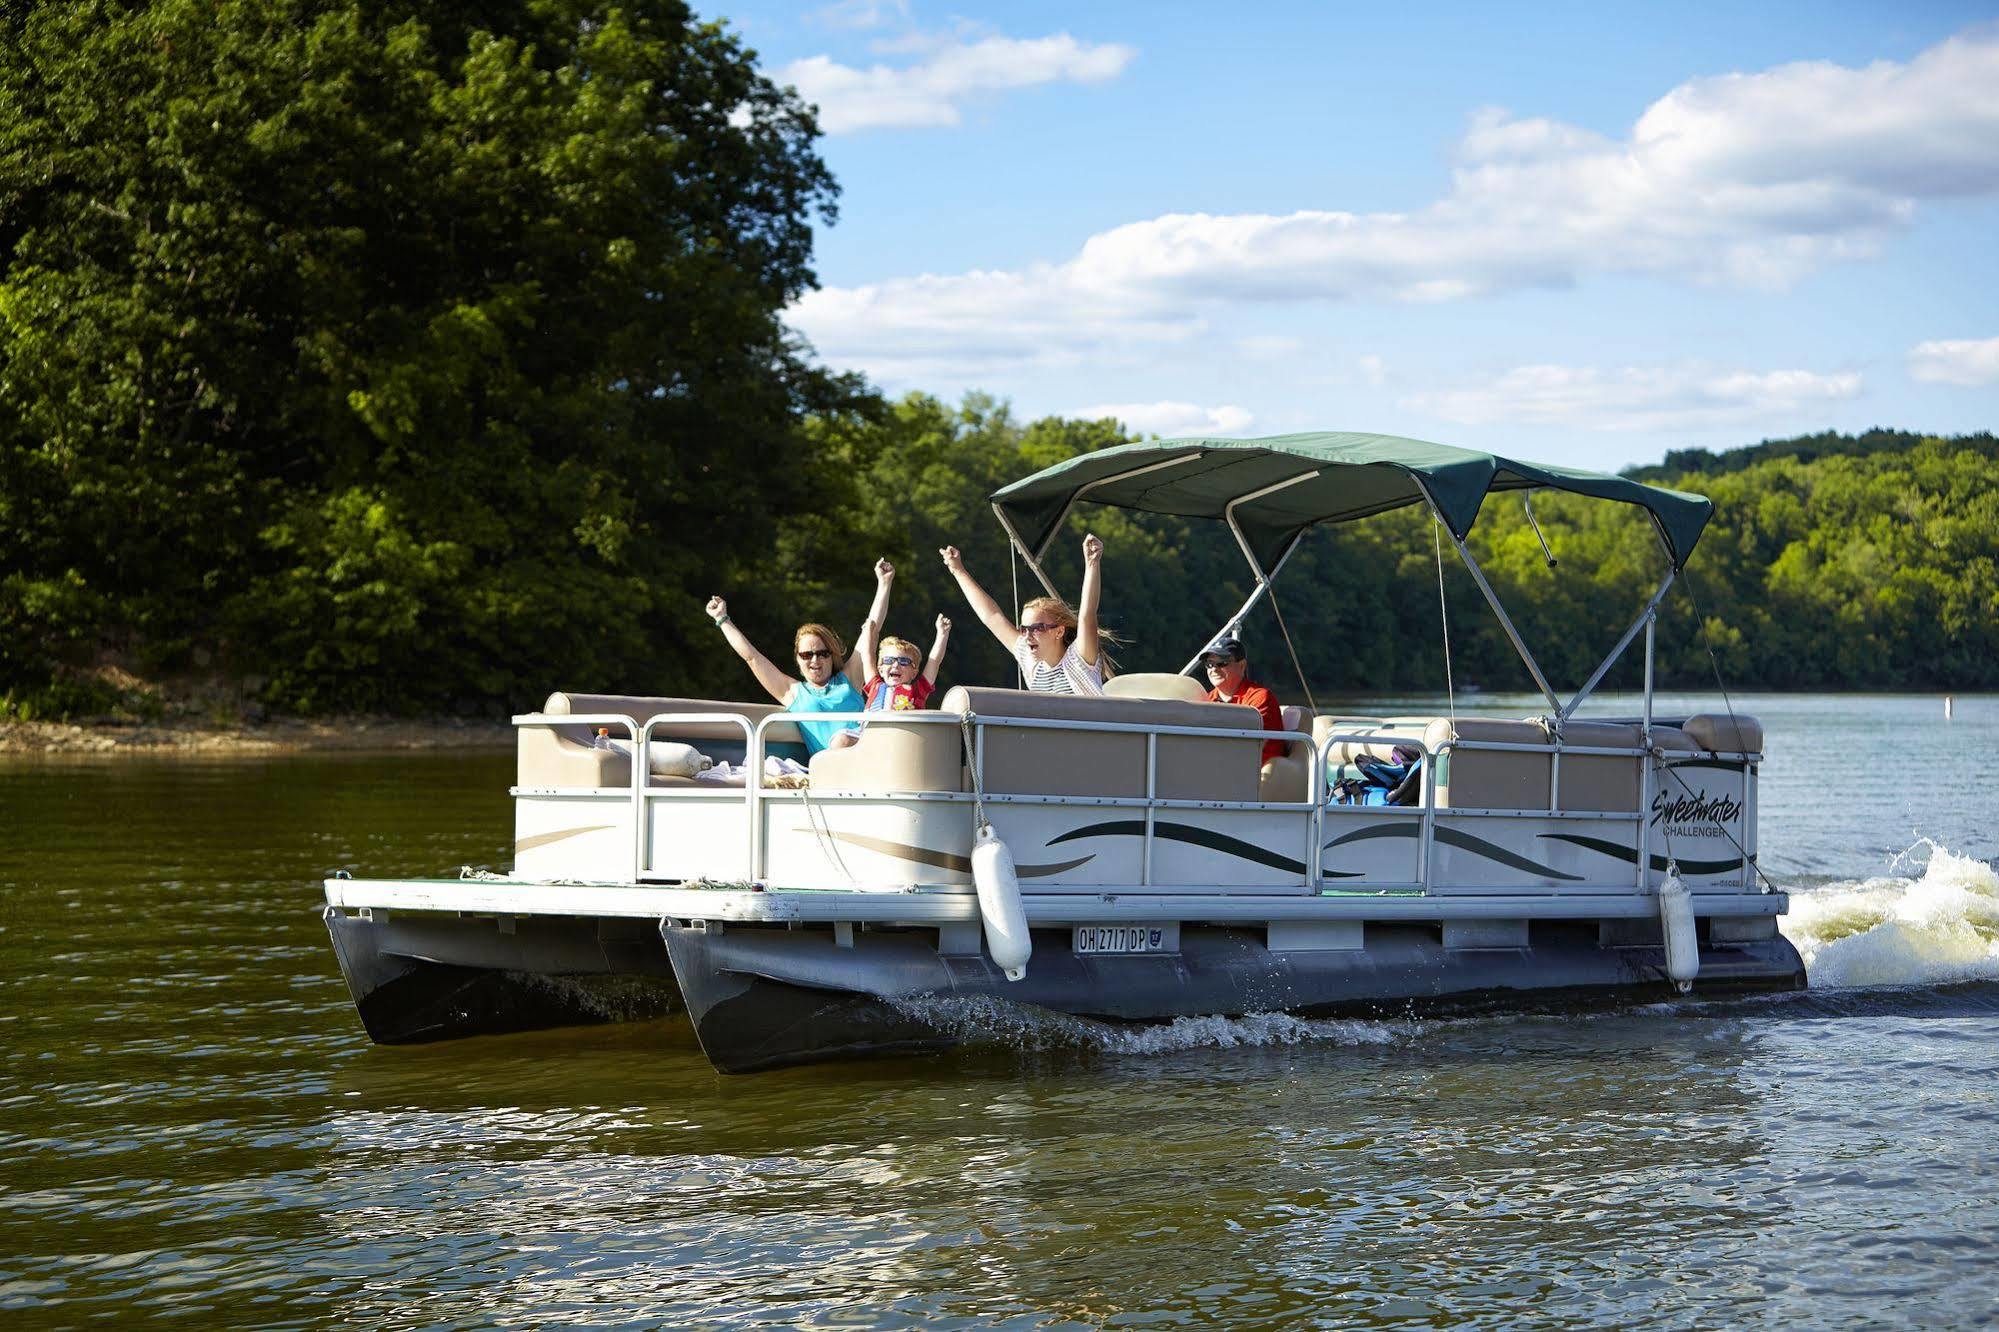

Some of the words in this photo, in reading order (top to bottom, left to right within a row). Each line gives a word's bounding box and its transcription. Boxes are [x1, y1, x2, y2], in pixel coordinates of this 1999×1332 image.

[1650, 789, 1742, 828] Sweetwater
[1663, 827, 1725, 838] CHALLENGER
[1080, 929, 1095, 950] OH
[1099, 928, 1125, 949] 2717
[1131, 928, 1145, 949] DP
